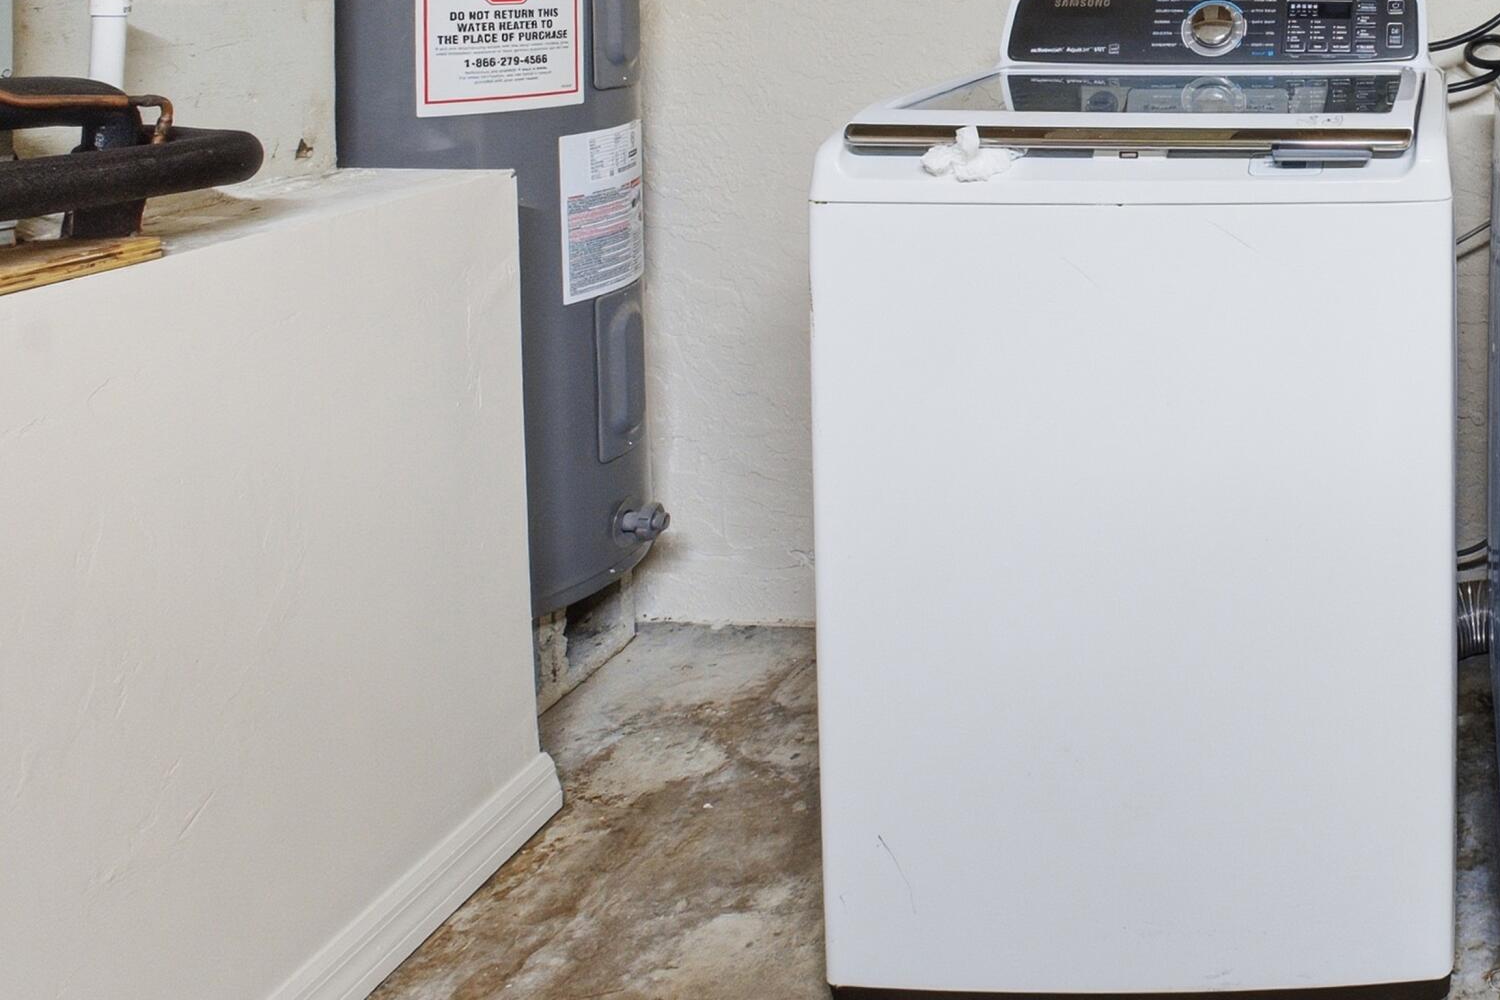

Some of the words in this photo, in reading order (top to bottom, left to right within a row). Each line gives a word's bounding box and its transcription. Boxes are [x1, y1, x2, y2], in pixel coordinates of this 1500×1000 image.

[449, 11, 465, 21] DO
[469, 10, 490, 20] NOT
[494, 8, 535, 20] RETURN
[538, 7, 559, 18] THIS
[457, 21, 495, 33] WATER
[499, 20, 538, 32] HEATER
[541, 19, 553, 29] TO
[437, 34, 459, 45] THE
[462, 32, 498, 44] PLACE
[501, 31, 515, 42] OF
[518, 29, 568, 41] PURCHASE
